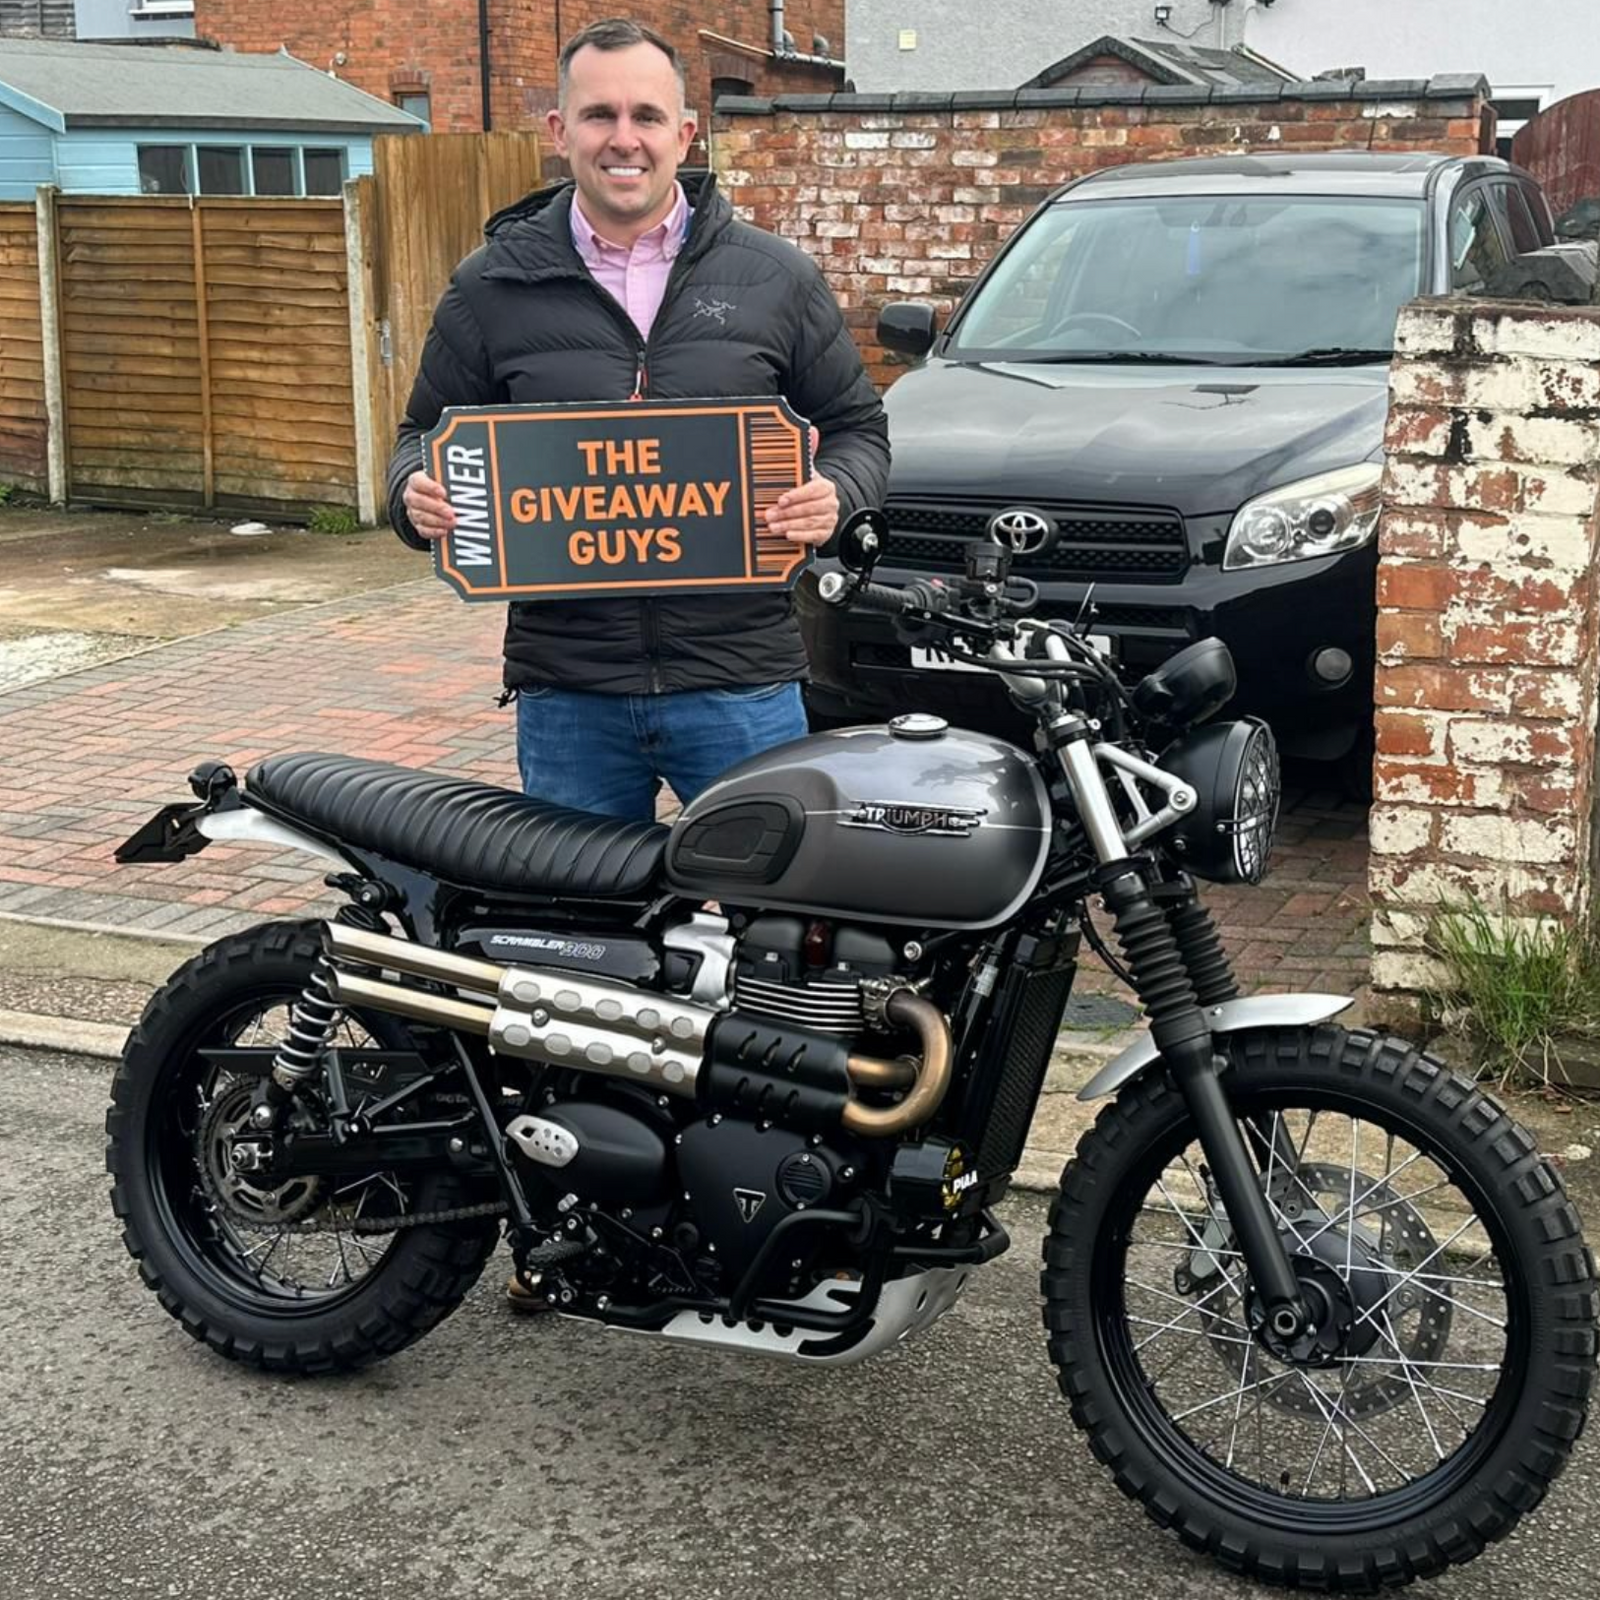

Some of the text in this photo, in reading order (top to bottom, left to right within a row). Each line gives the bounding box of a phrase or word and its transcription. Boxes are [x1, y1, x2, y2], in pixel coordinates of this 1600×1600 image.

[577, 438, 662, 476] THE
[446, 443, 493, 567] WINNER
[510, 481, 731, 523] GIVEAWAY
[568, 527, 682, 565] GUYS
[865, 806, 949, 829] TRIUMPH
[490, 934, 565, 950] SCRAMBLER
